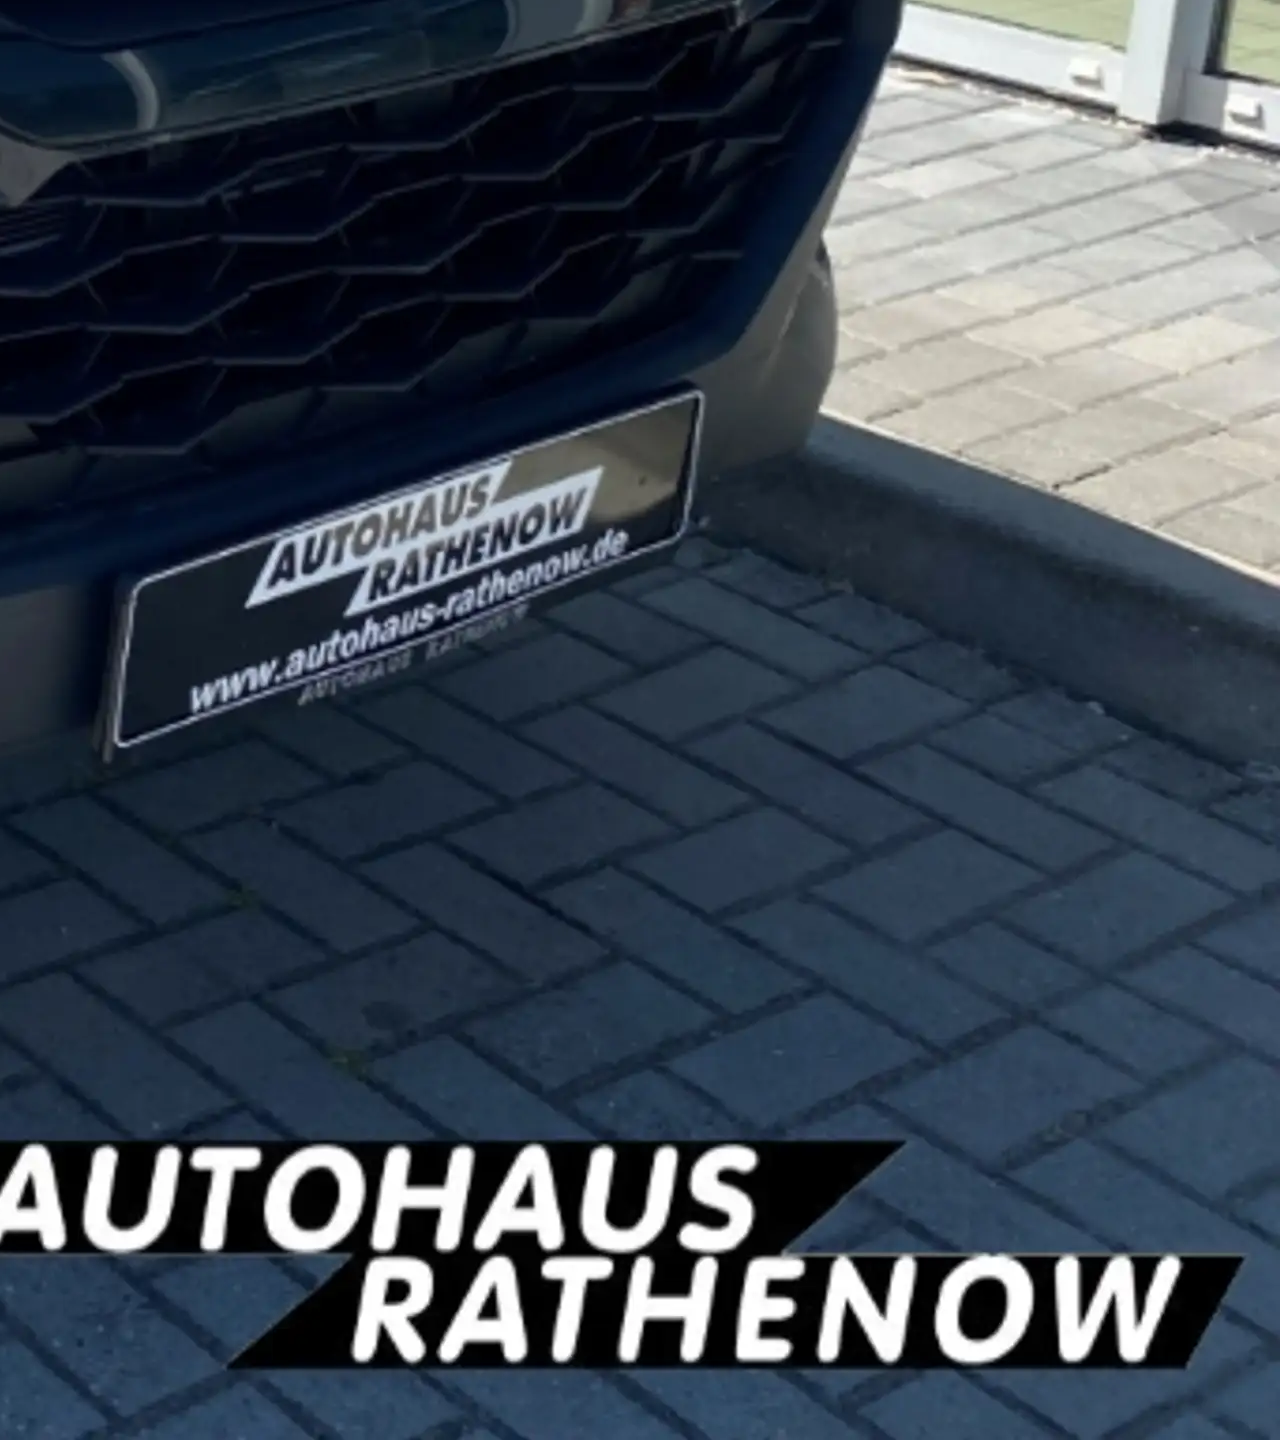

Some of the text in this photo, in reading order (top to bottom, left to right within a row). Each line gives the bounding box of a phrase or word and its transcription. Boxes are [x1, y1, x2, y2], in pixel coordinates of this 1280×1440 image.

[266, 473, 493, 590] AUTOHAUS
[368, 486, 587, 602] RATHENOW
[189, 528, 629, 715] www.autohaus-rathenow.de
